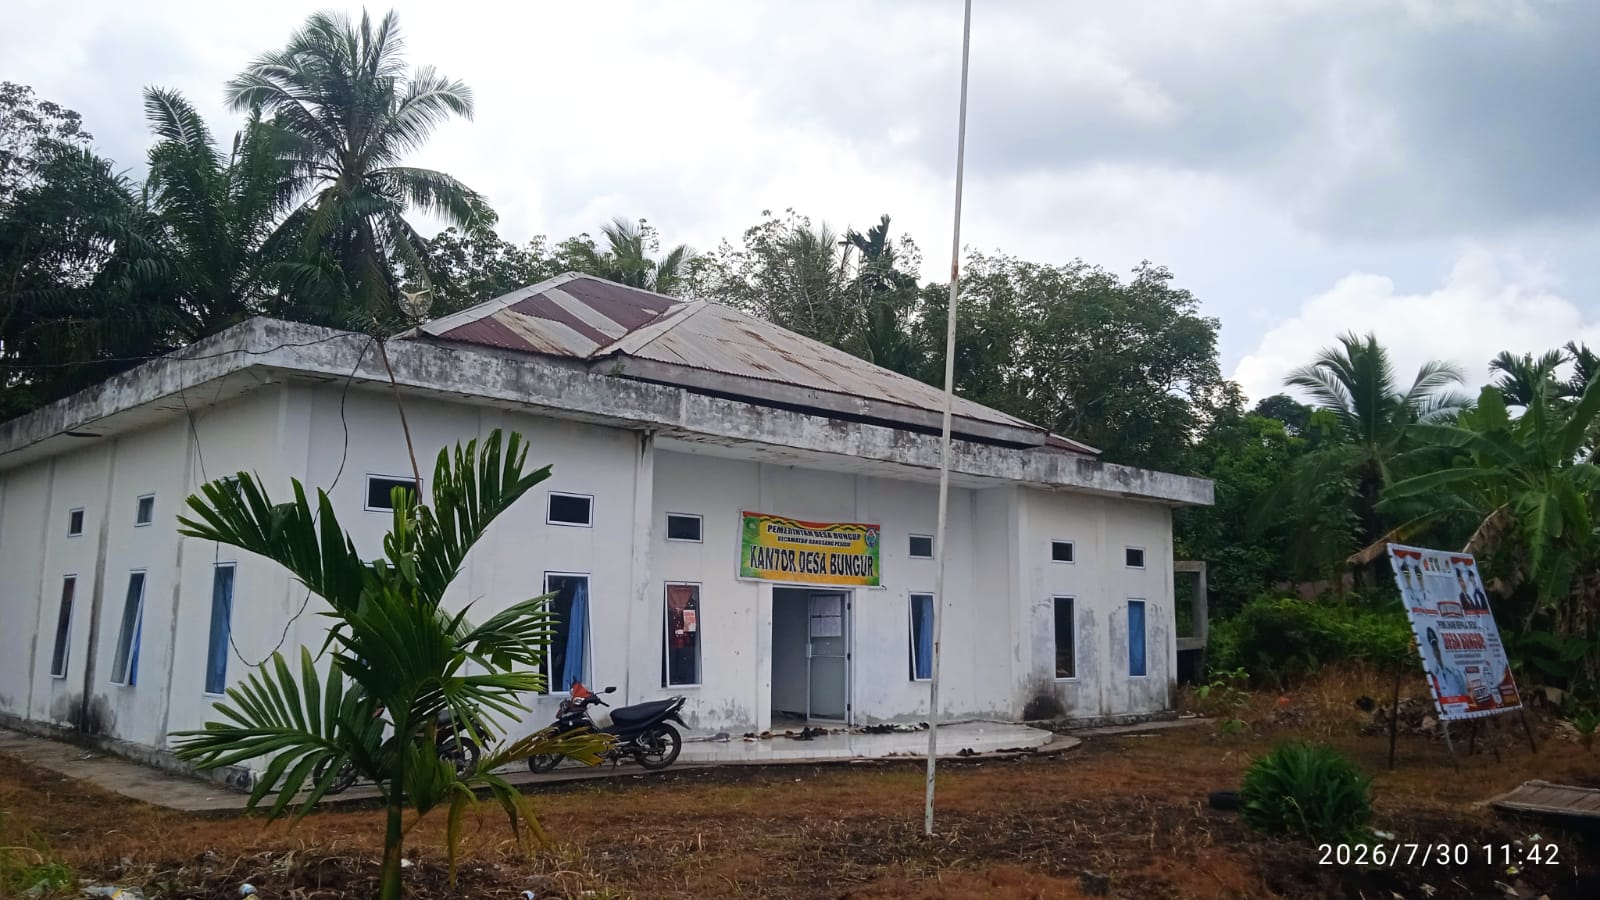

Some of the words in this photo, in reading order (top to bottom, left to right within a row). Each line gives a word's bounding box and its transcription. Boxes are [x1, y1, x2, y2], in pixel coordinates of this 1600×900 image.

[767, 524, 814, 537] PEMERINTAH
[814, 531, 833, 539] DESA
[833, 532, 861, 541] BUNGUR
[750, 545, 797, 573] KANTOR
[799, 551, 827, 575] DESA
[829, 553, 873, 577] BUNGUR
